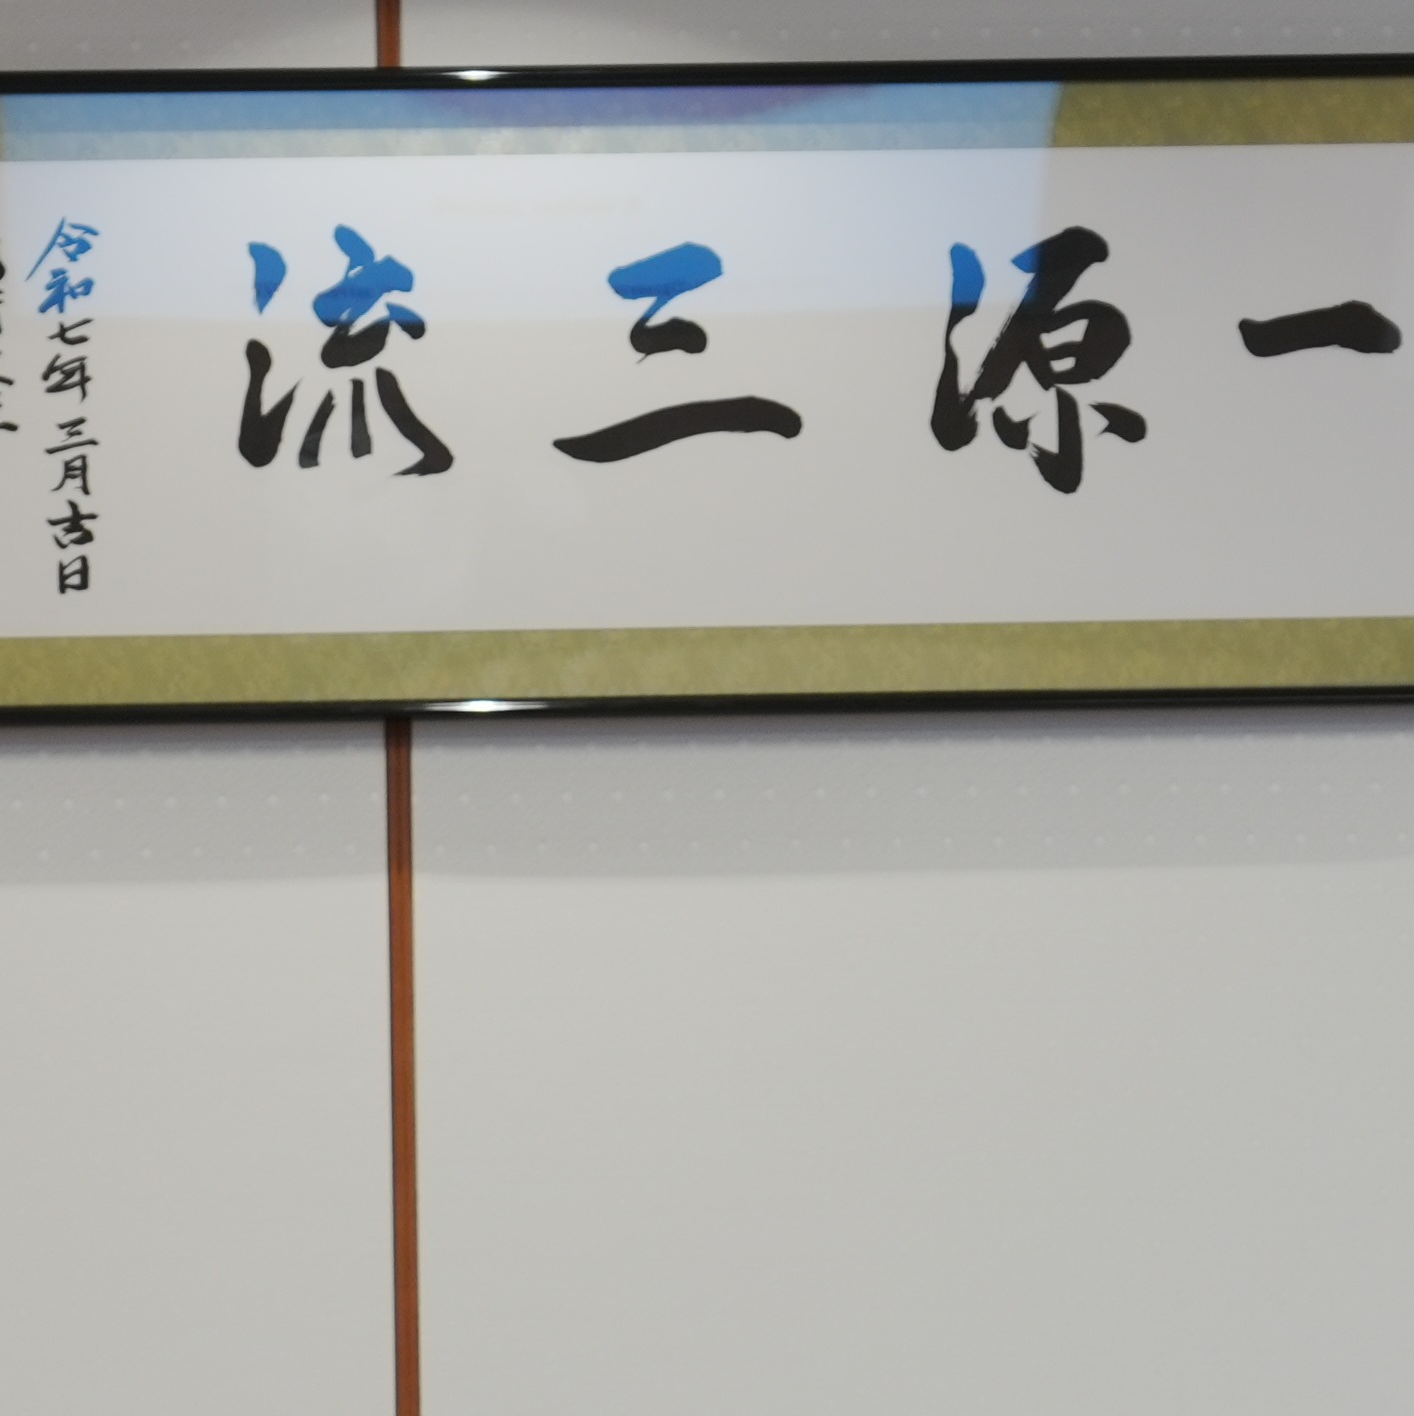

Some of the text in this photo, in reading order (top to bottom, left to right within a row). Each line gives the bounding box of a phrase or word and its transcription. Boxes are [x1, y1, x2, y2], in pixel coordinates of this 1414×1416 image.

[27, 217, 100, 594] 令和七年三月吉日
